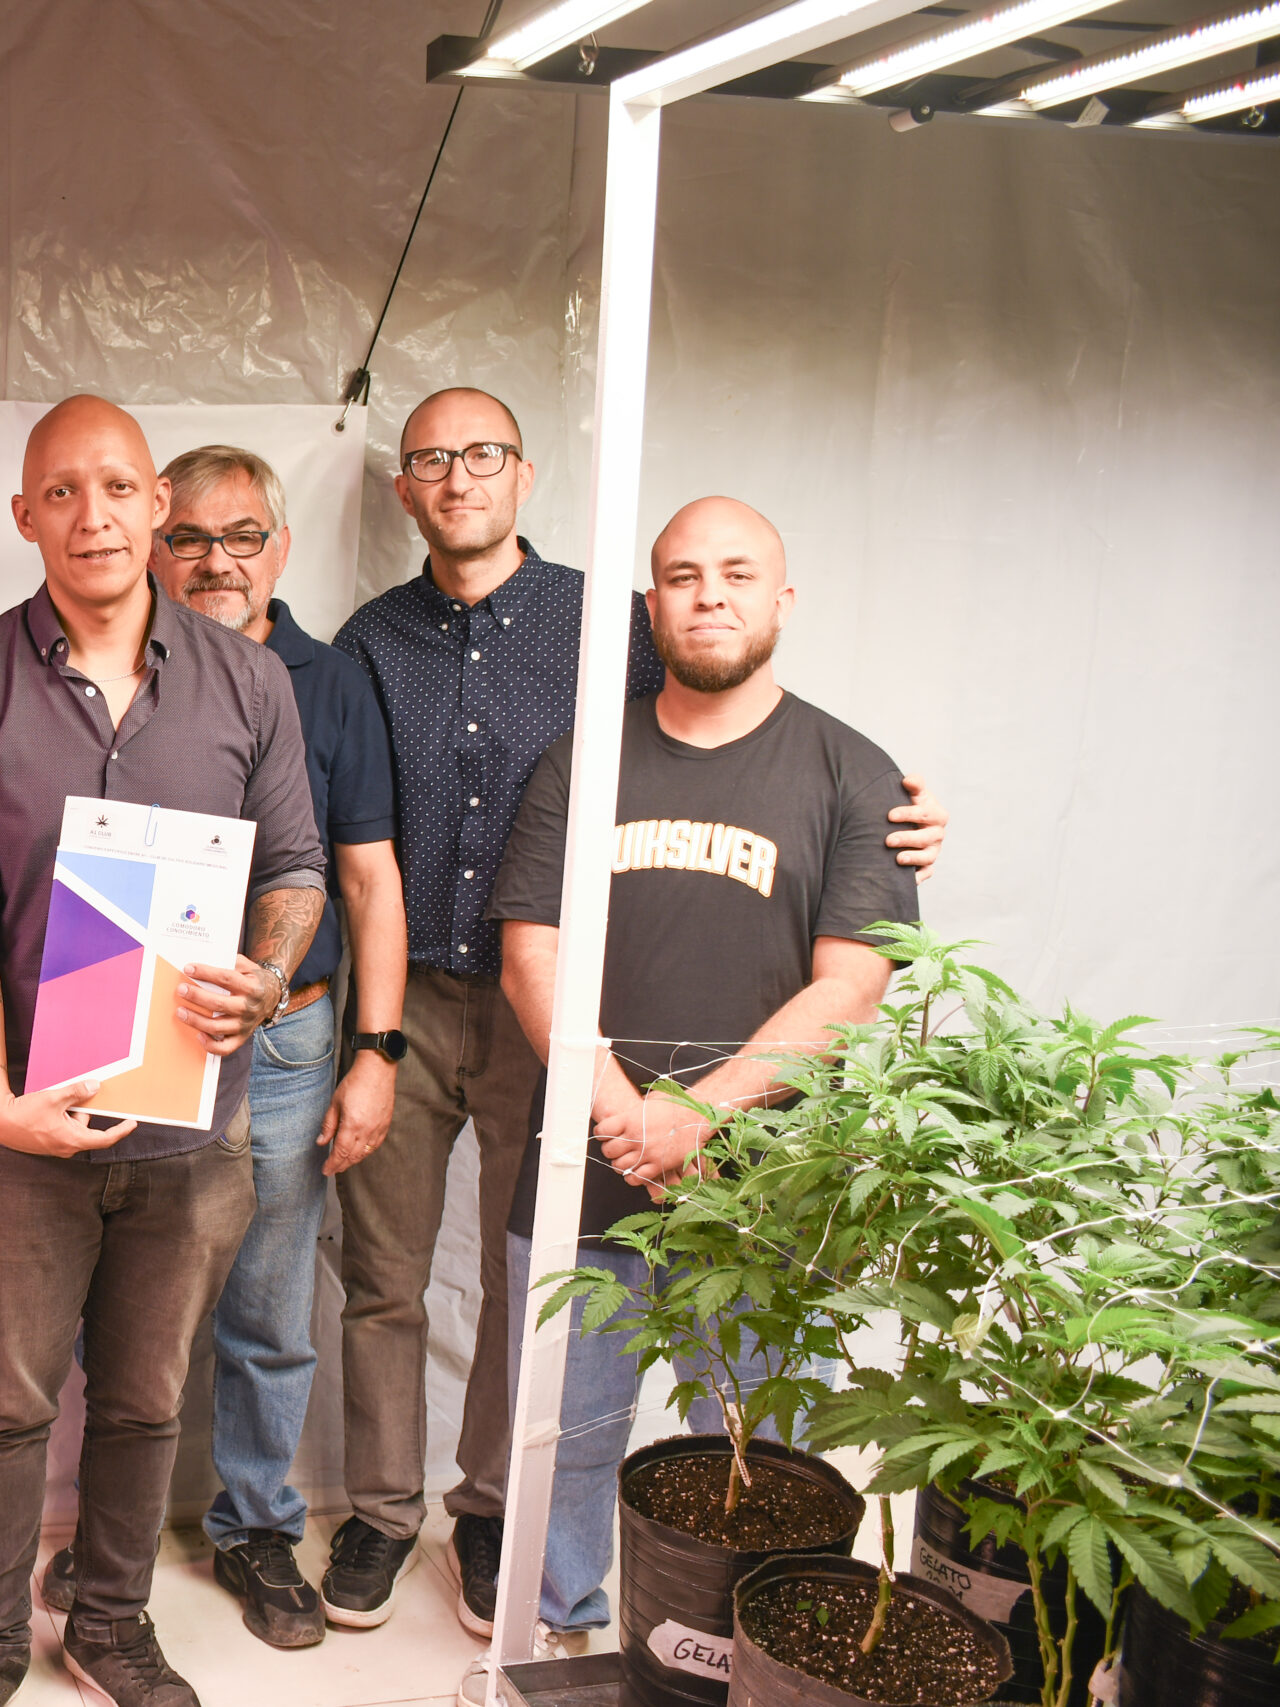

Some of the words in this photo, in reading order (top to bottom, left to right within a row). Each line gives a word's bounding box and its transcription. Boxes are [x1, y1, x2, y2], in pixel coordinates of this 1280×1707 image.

[612, 819, 777, 898] UIKSILVER
[166, 927, 210, 937] CONOCIMIENTO
[172, 922, 206, 931] COMODORO
[920, 1547, 971, 1589] GELATO
[674, 1638, 733, 1674] GELA
